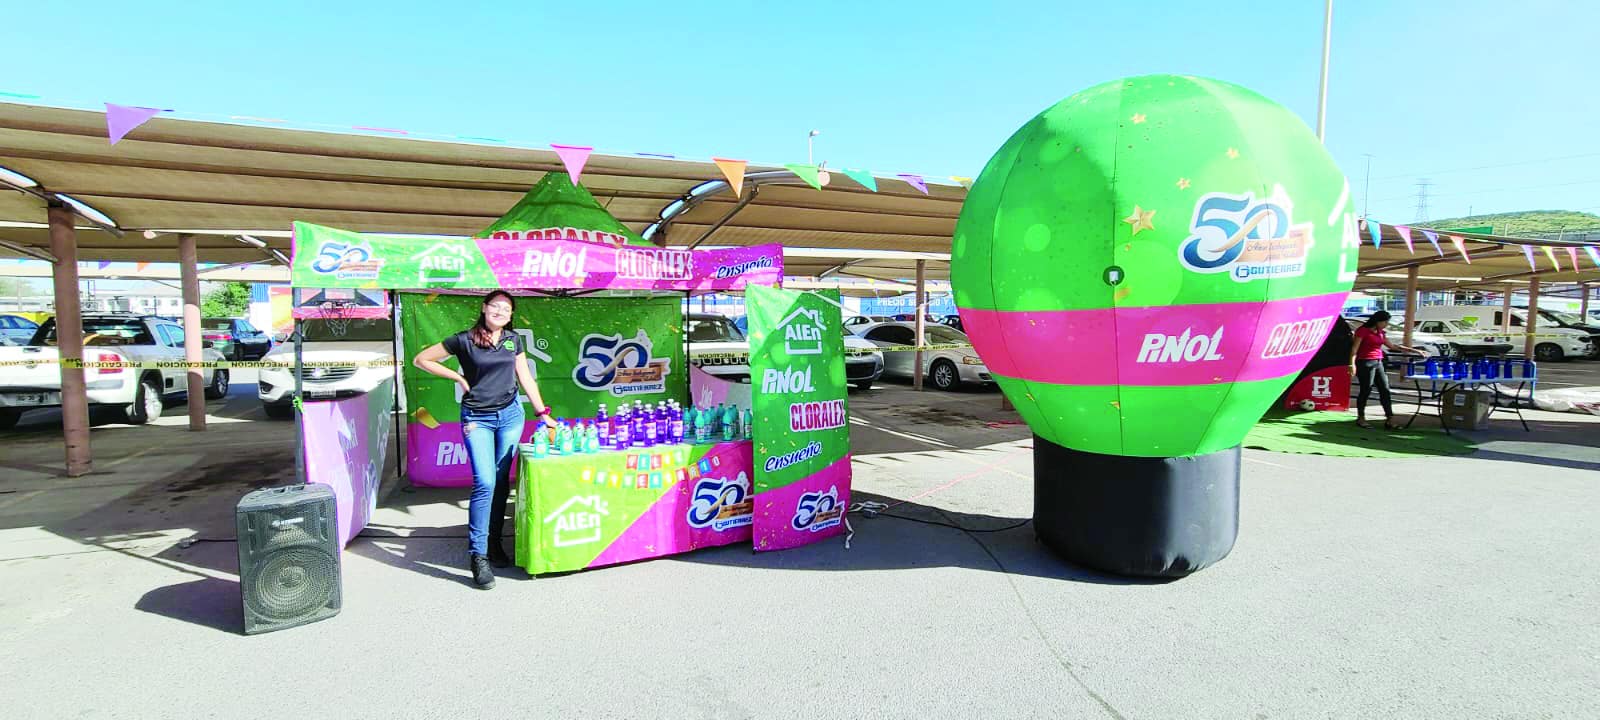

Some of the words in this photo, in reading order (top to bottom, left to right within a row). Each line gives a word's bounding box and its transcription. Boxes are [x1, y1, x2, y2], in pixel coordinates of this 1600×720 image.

[1184, 197, 1289, 268] 50
[313, 243, 369, 273] 50
[617, 249, 692, 279] CLORALEX
[717, 256, 773, 279] ensueño
[576, 337, 648, 388] 50
[791, 401, 845, 431] CLORALEX
[765, 441, 821, 471] ensueño
[690, 481, 745, 525] 50
[794, 494, 835, 528] 50
